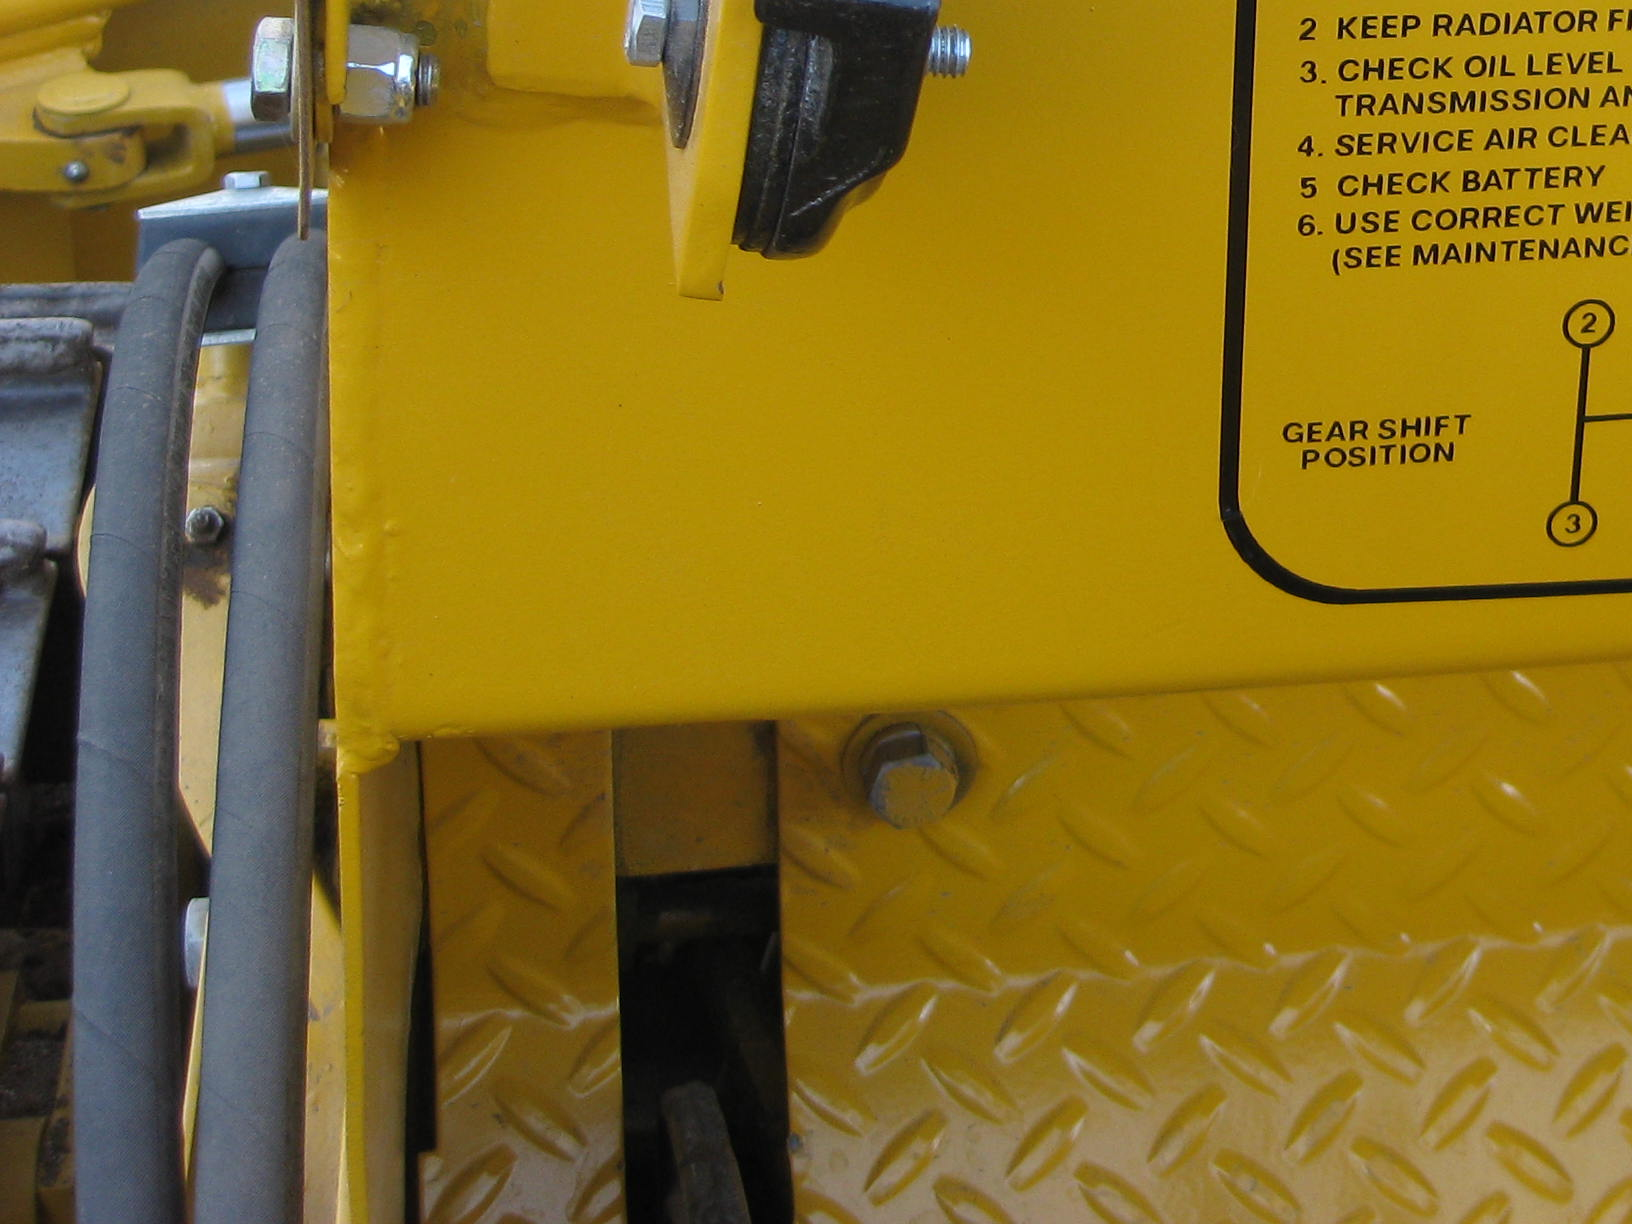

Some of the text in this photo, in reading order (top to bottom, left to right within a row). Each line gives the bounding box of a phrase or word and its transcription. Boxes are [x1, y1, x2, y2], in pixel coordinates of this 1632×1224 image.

[1298, 17, 1317, 41] 2
[1337, 14, 1421, 40] KEEP
[1432, 9, 1598, 37] RADIATOR
[1299, 60, 1327, 84] 3.
[1338, 56, 1453, 82] CHECK
[1464, 54, 1516, 78] OIL
[1526, 51, 1623, 76] LEVEL
[1334, 86, 1590, 117] TRANSMISSION
[1297, 135, 1323, 157] 4.
[1334, 129, 1474, 157] SERVICE
[1483, 127, 1538, 151] AIR
[1300, 164, 1606, 199] 5 CHECK BATTERY
[1297, 214, 1323, 237] 6.
[1335, 210, 1401, 235] USE
[1411, 203, 1566, 232] CORRECT
[1332, 245, 1402, 276] (SEE
[1580, 312, 1597, 334] 2
[1282, 414, 1472, 444] GEAR SHIFT
[1301, 441, 1455, 470] POSITION
[1564, 513, 1581, 534] 3
